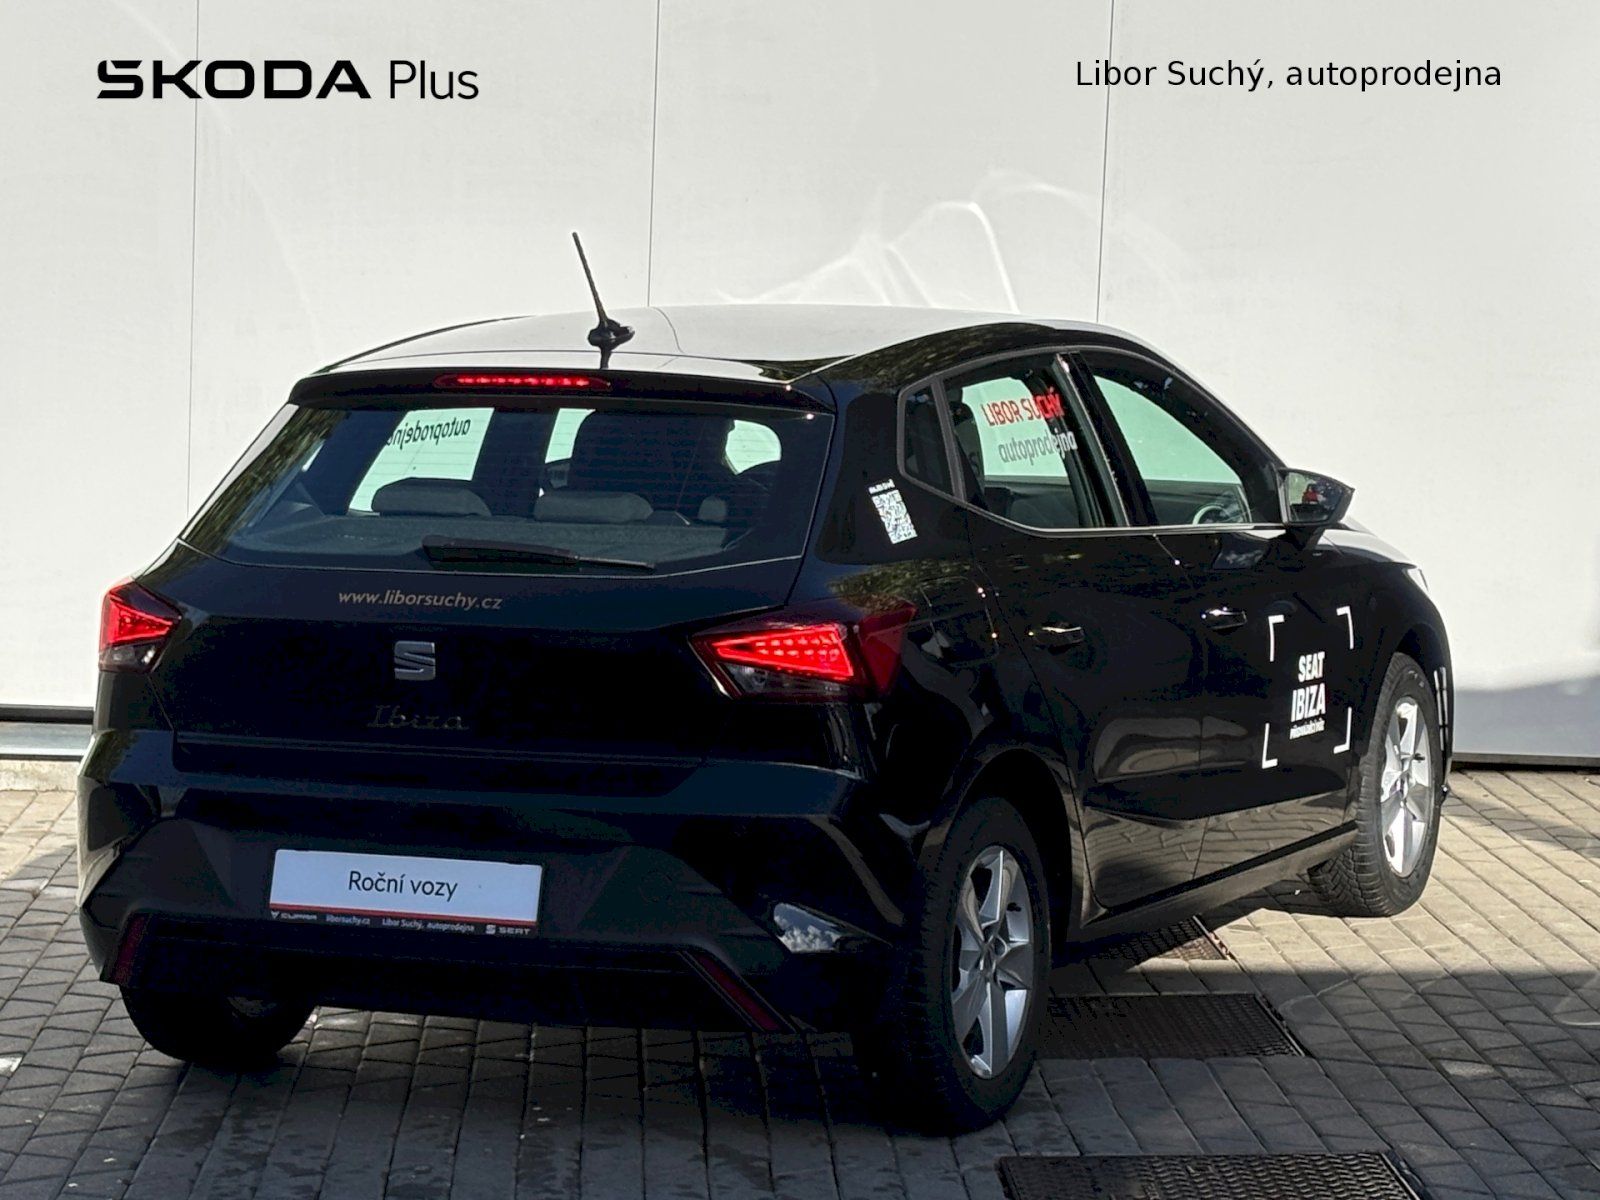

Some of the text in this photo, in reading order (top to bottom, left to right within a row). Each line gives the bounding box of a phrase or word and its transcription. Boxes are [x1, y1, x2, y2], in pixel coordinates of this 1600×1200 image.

[981, 400, 1023, 427] LIBOR
[998, 428, 1078, 466] autoprodejna
[338, 589, 503, 611] www.liborsuchy.cz
[1298, 652, 1325, 682] SEAT
[1290, 683, 1326, 722] IBIZA
[366, 704, 470, 731] Ibiza
[348, 870, 458, 903] Roční vozy
[499, 927, 531, 935] SEAT
